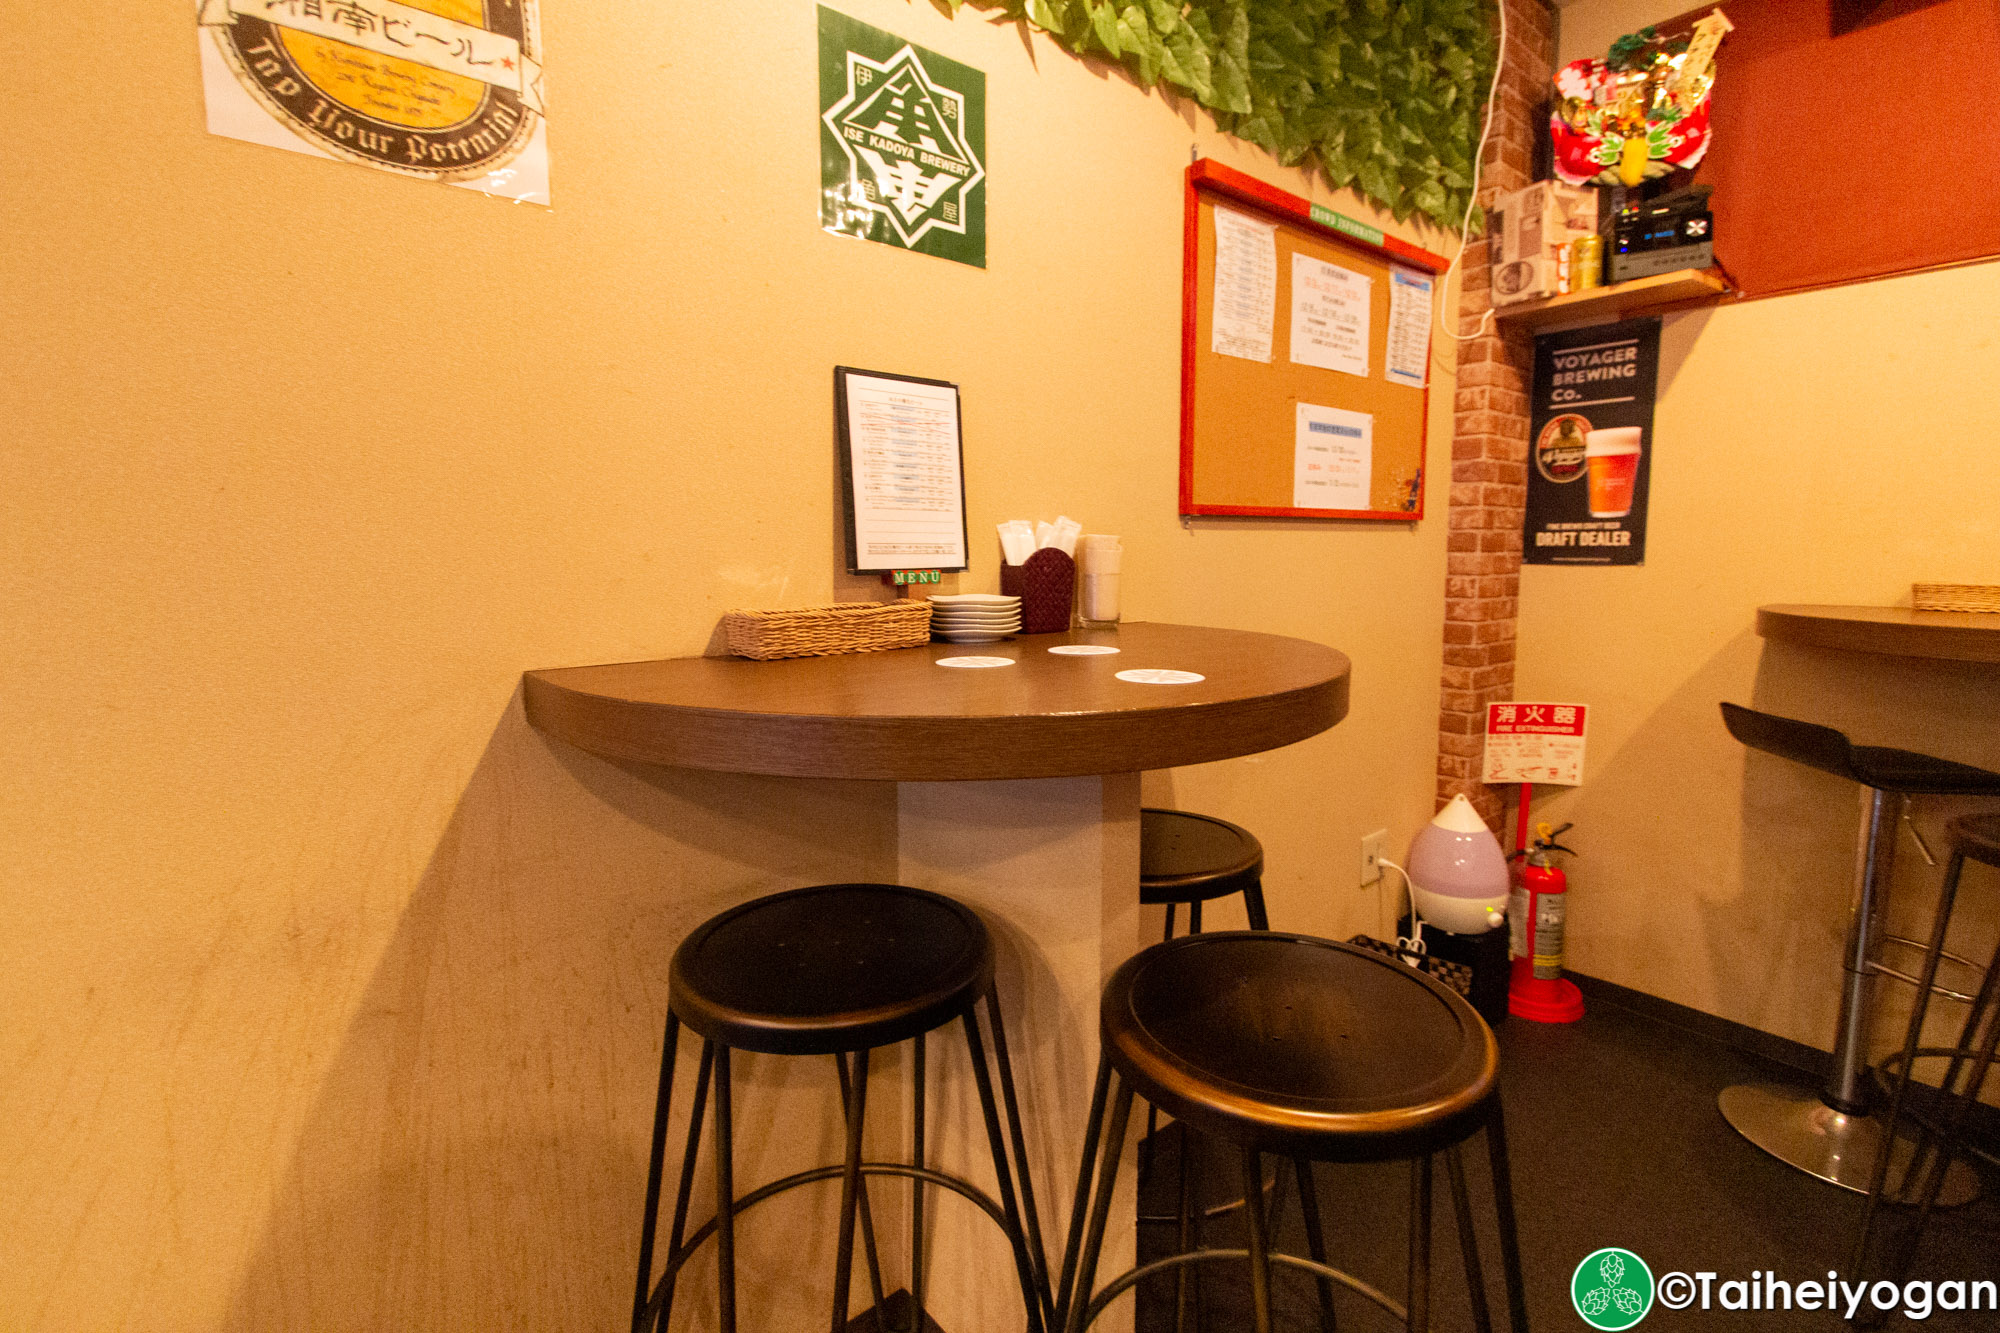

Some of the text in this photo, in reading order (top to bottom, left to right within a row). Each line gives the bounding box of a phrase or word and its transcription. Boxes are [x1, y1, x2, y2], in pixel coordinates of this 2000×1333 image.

[844, 126, 971, 178] ISE KADOYA BREWERY
[1553, 346, 1639, 370] VOYAGER
[1552, 363, 1638, 387] BREWING
[1535, 530, 1632, 547] DRAFT DEALER
[893, 571, 940, 584] MENU
[1496, 705, 1577, 724] 消火器
